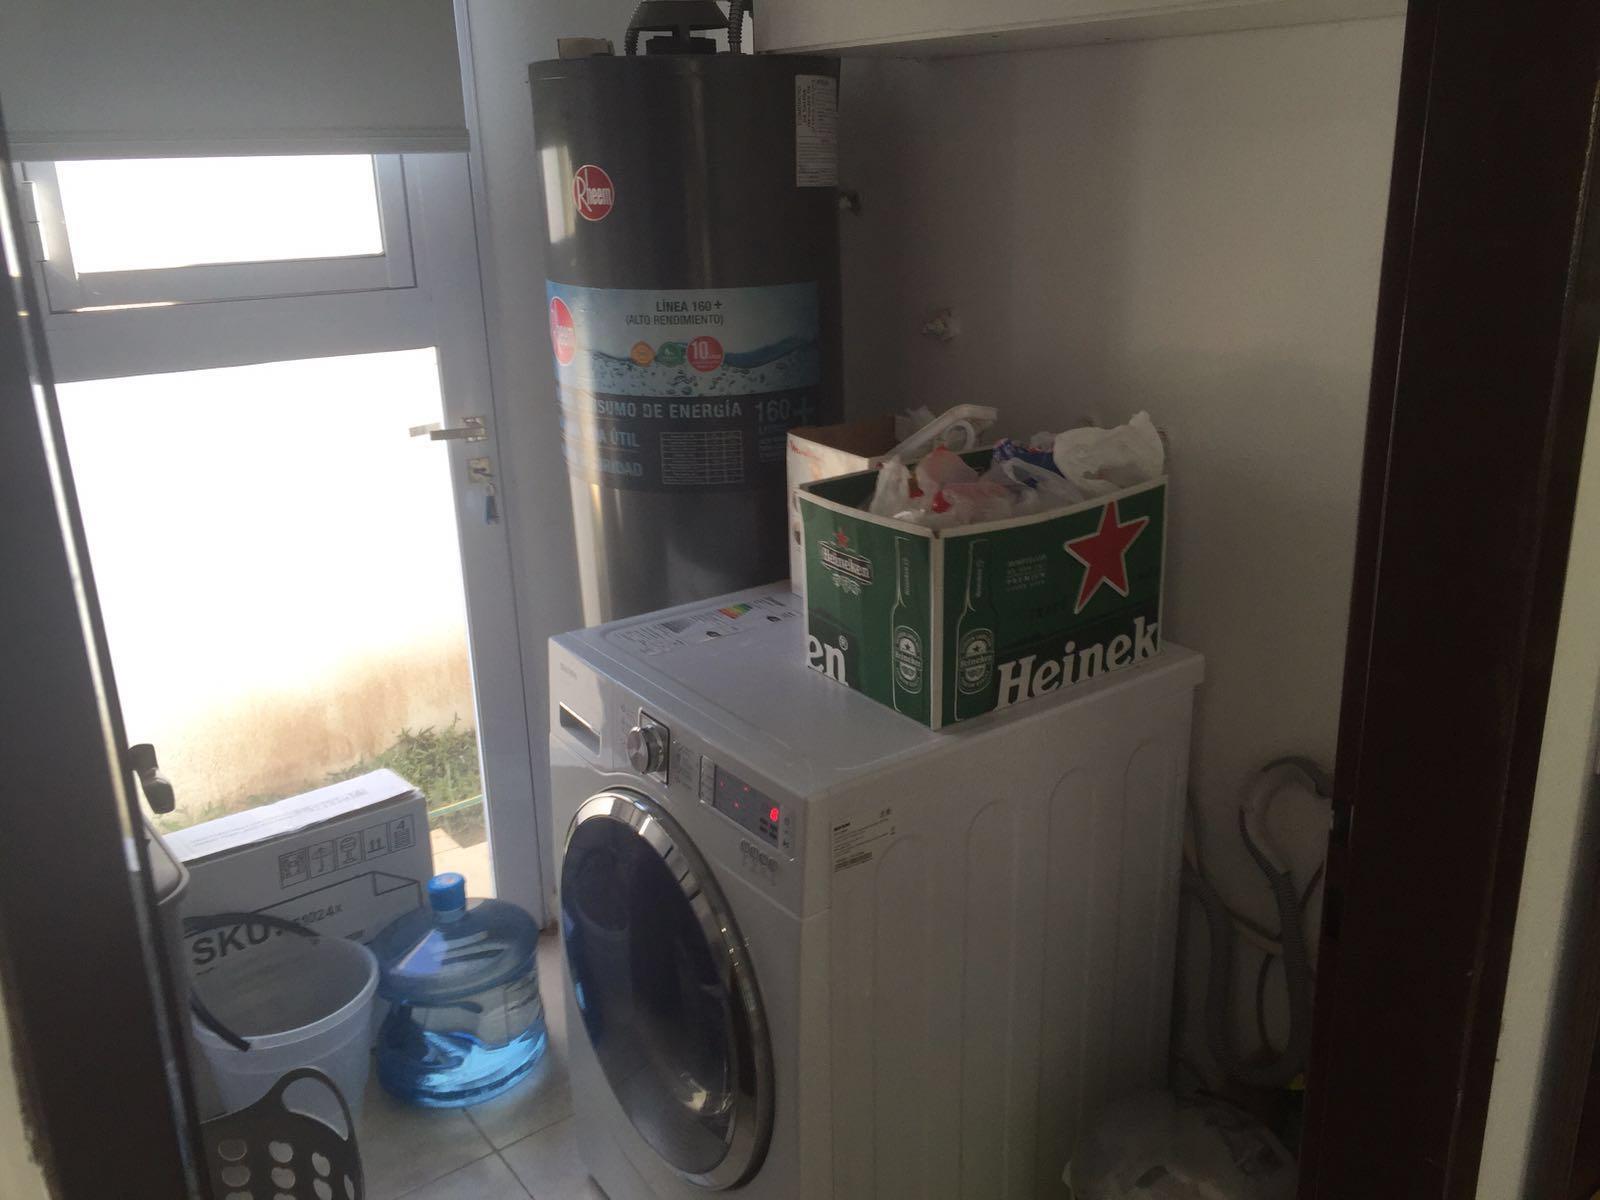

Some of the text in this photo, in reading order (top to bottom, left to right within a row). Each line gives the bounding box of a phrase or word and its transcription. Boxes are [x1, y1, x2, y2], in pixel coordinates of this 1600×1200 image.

[576, 167, 612, 213] Rheem
[656, 299, 688, 313] LÍNEA
[691, 341, 709, 360] 10
[643, 403, 663, 418] DE
[669, 400, 743, 419] ENERGÍA
[822, 545, 870, 579] Heineken
